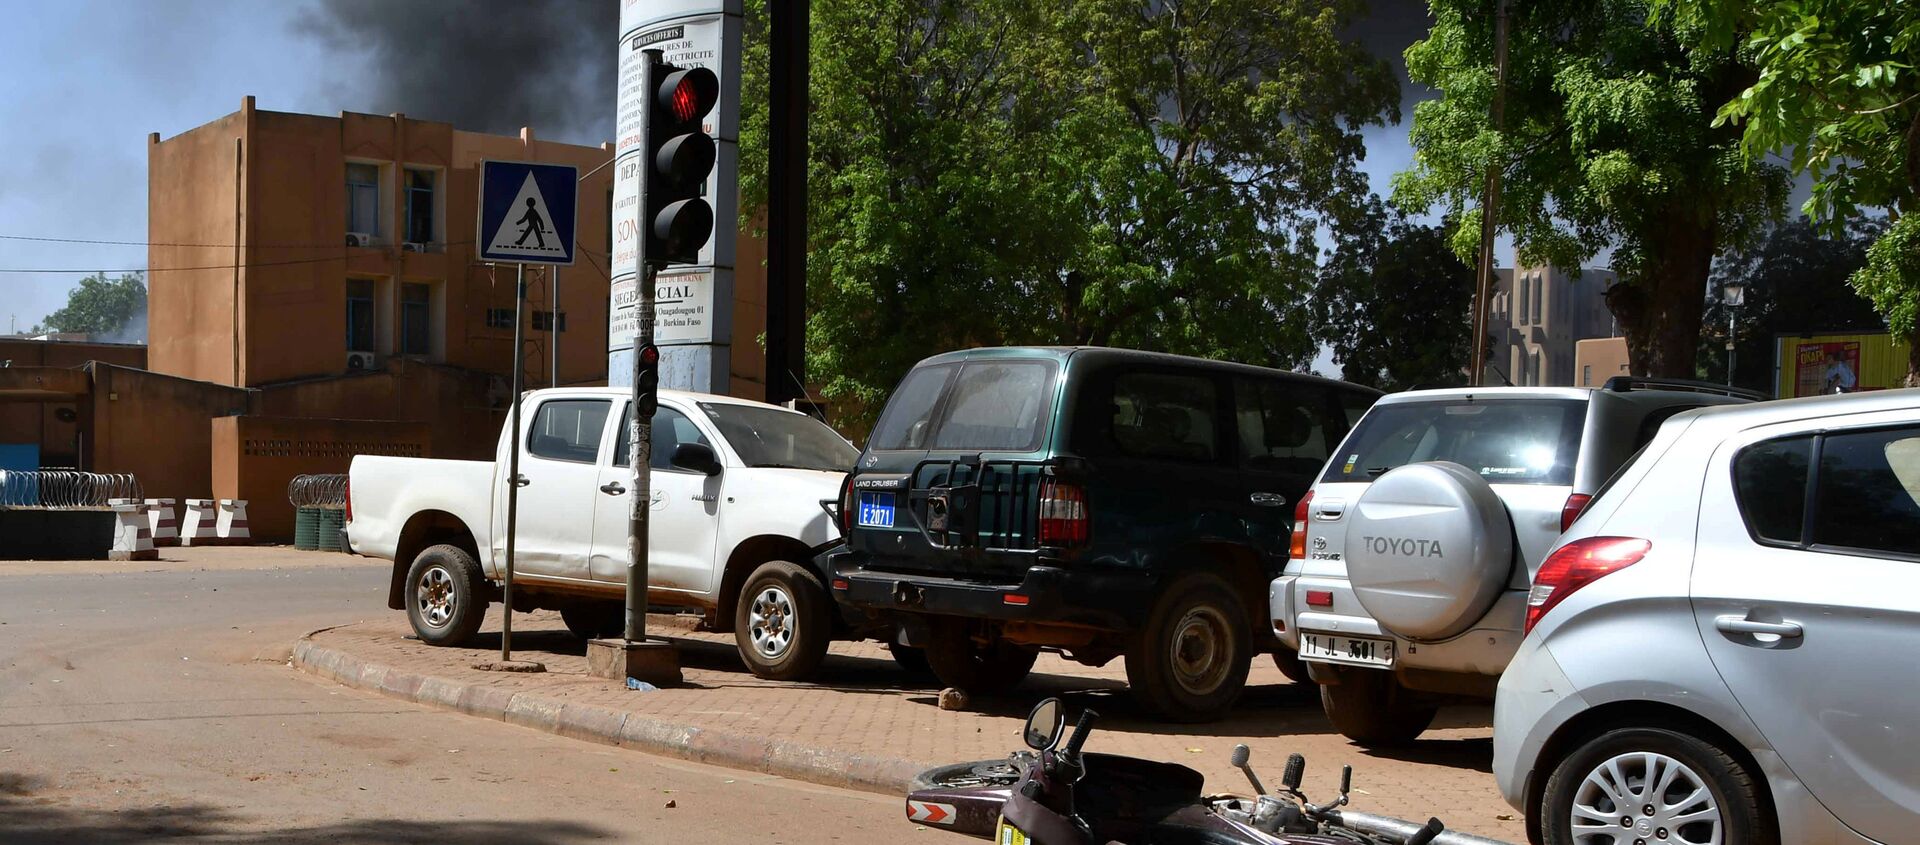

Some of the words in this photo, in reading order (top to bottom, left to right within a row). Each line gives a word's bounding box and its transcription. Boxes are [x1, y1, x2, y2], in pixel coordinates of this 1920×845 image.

[633, 33, 654, 48] SERVICES
[654, 28, 678, 42] OFFERTS
[682, 40, 693, 48] DE
[666, 50, 714, 61] LECTRICITE
[657, 286, 694, 299] CIAL
[658, 306, 696, 316] Ouagadougou
[687, 318, 701, 326] Faso
[870, 509, 889, 526] 2071
[1363, 536, 1443, 558] TOYOTA
[1306, 635, 1317, 654] 11
[1325, 637, 1338, 656] JL
